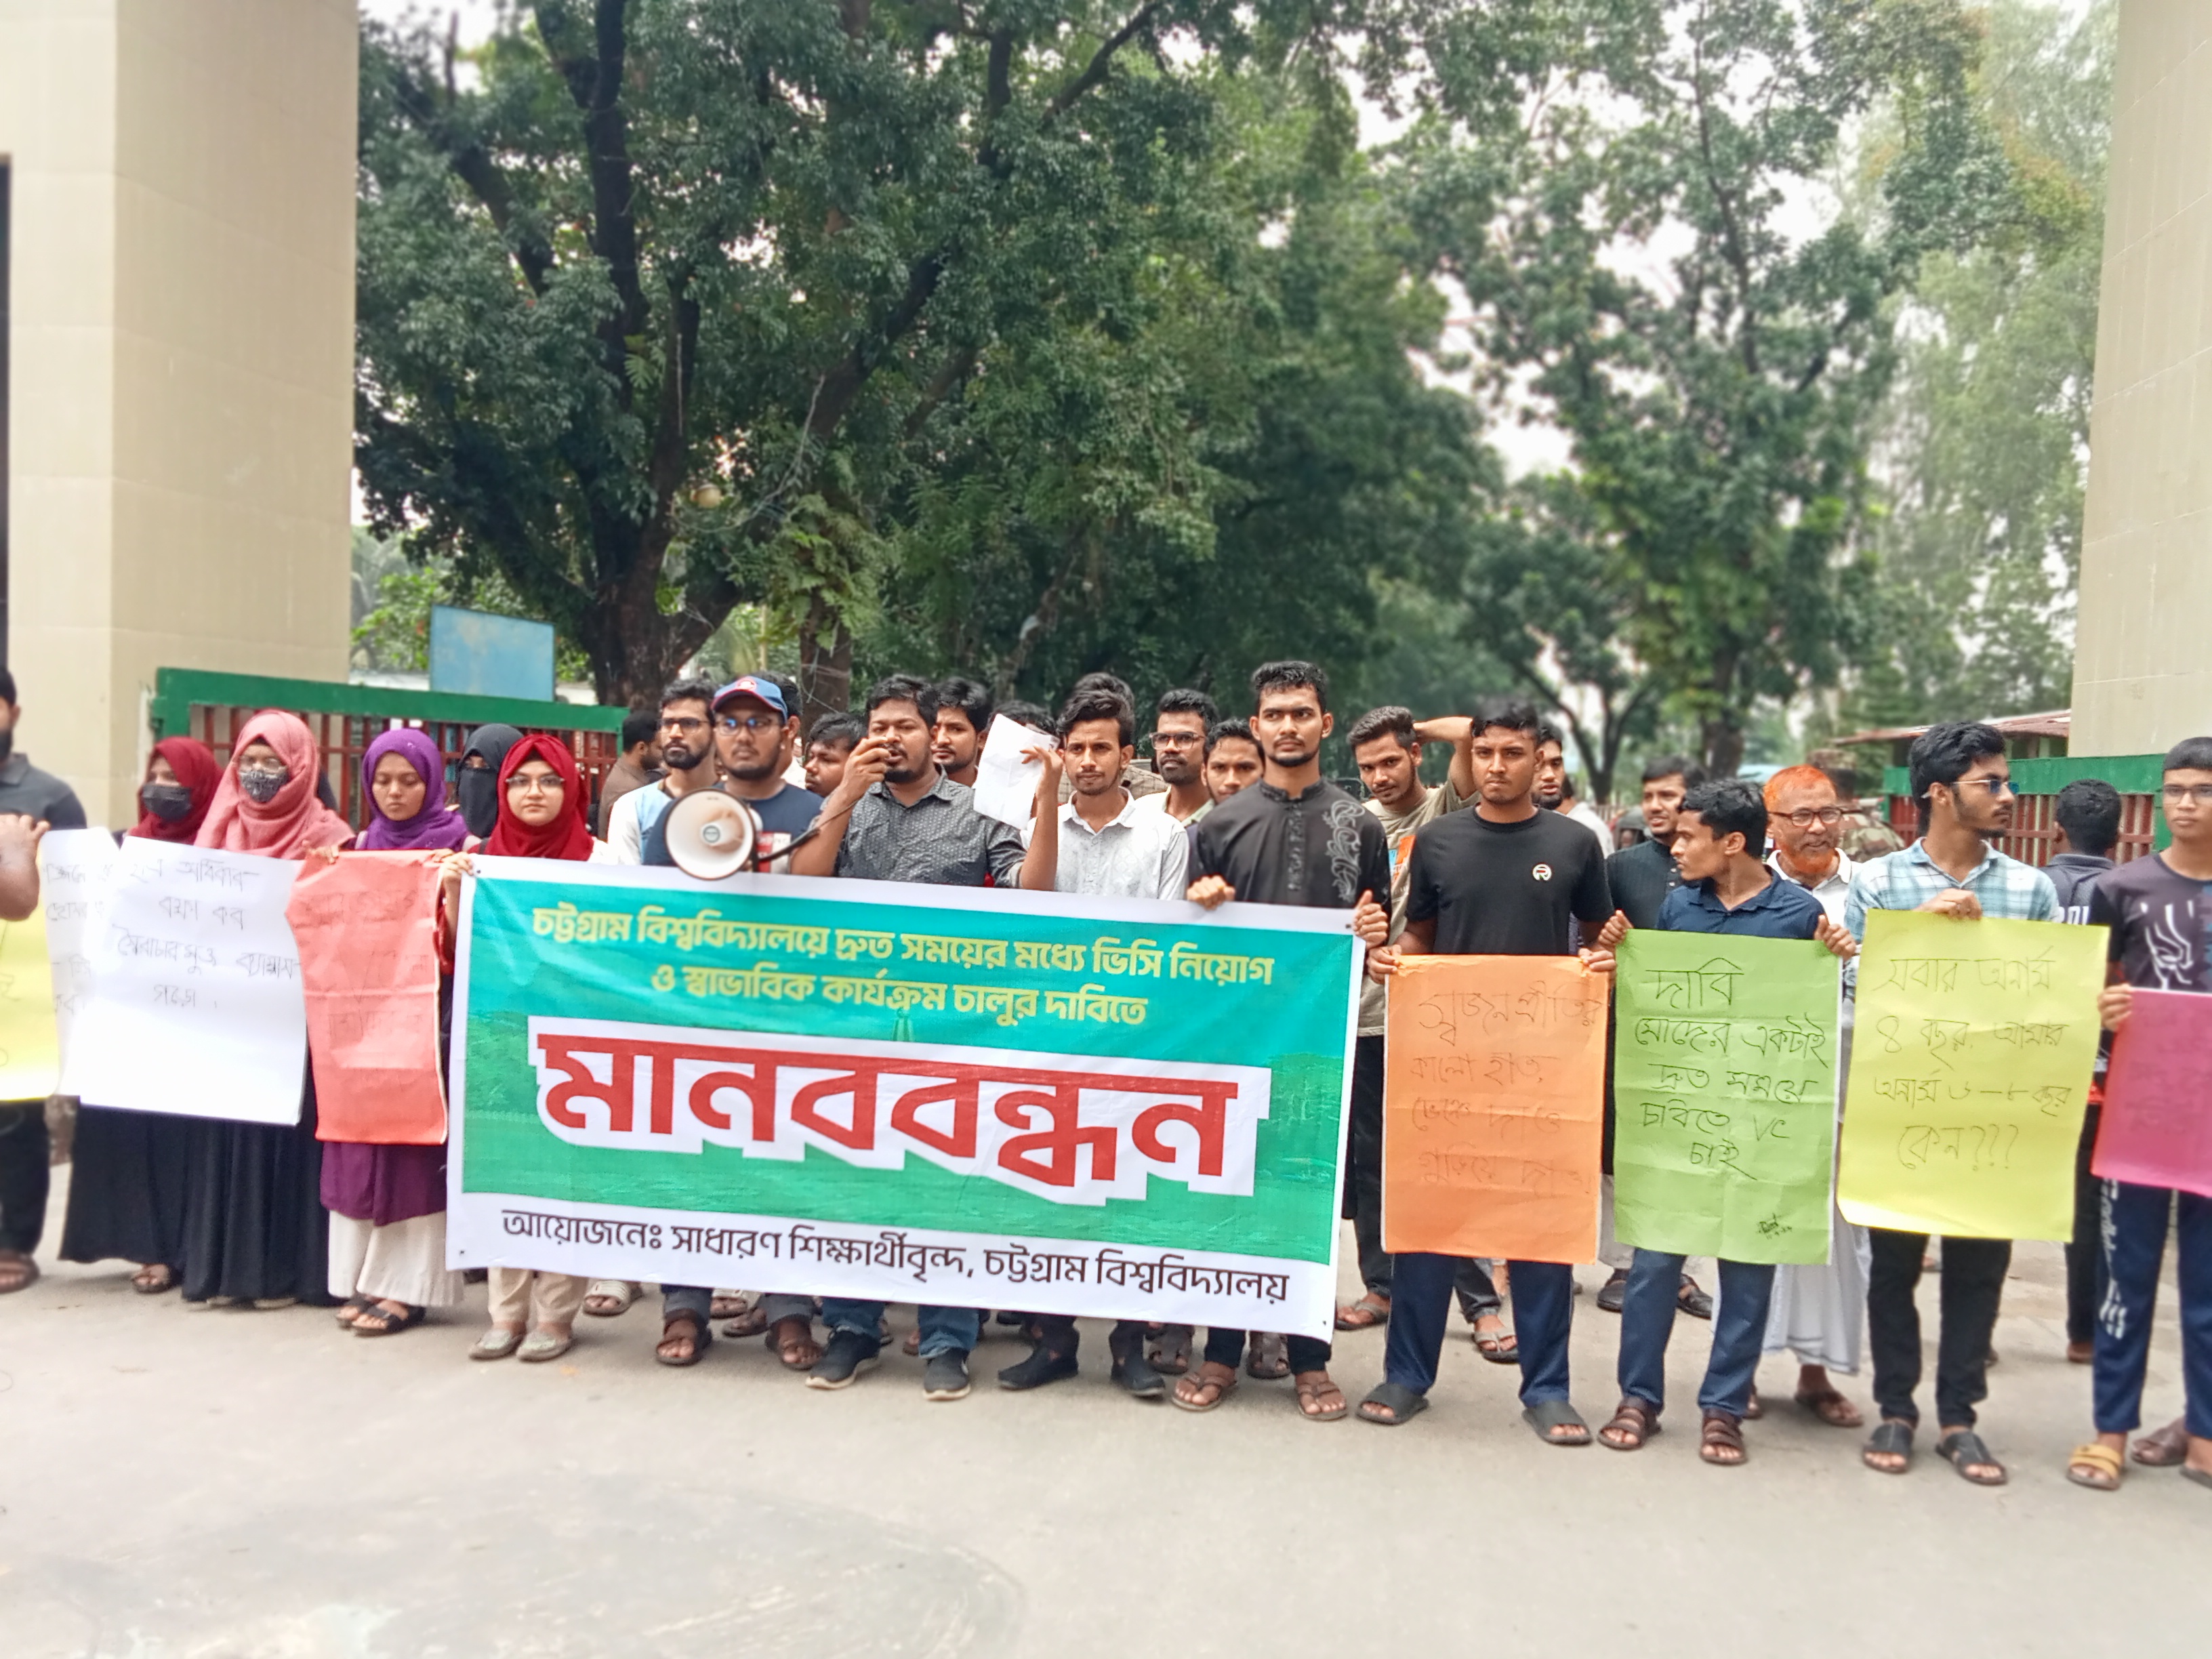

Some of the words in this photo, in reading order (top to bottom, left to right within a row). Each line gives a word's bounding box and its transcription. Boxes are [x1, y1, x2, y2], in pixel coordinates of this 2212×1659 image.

[533, 901, 633, 943] চট্টগ্রাম
[637, 905, 830, 958] বিশ্ববিদ্যালয়ে
[835, 928, 895, 961] দ্রুত
[901, 933, 1008, 969] সময়ের
[1014, 941, 1086, 972] মধ্যে
[1092, 936, 1164, 977] ভিসি
[1169, 941, 1275, 986] নিয়োগ
[651, 964, 676, 991] ও
[682, 961, 817, 1001] স্বাভাবিক
[821, 968, 947, 1010] কার্যক্রম
[954, 984, 1039, 1027] চালুর
[1044, 983, 1148, 1025] দাবিতে
[1645, 958, 1744, 1008] দাবি
[1974, 945, 2055, 996] অনার্স
[1635, 1018, 1732, 1054] মোদের
[1742, 1012, 1828, 1068] একটাই
[1877, 1015, 1902, 1053] ৪
[1994, 1020, 2070, 1049] আমার
[1410, 1053, 1479, 1083] কালো
[1647, 1063, 1709, 1090] দ্রুত
[1875, 1069, 1942, 1109] অনার্স
[538, 1033, 1237, 1187] মানববন্ধন
[1487, 1104, 1565, 1141] দাও
[1691, 1139, 1757, 1181] চাই
[671, 1225, 781, 1259] সাধারণ
[983, 1242, 1088, 1282] চট্টগ্রাম
[1095, 1248, 1289, 1305] বিশ্ববিদ্যালয়
